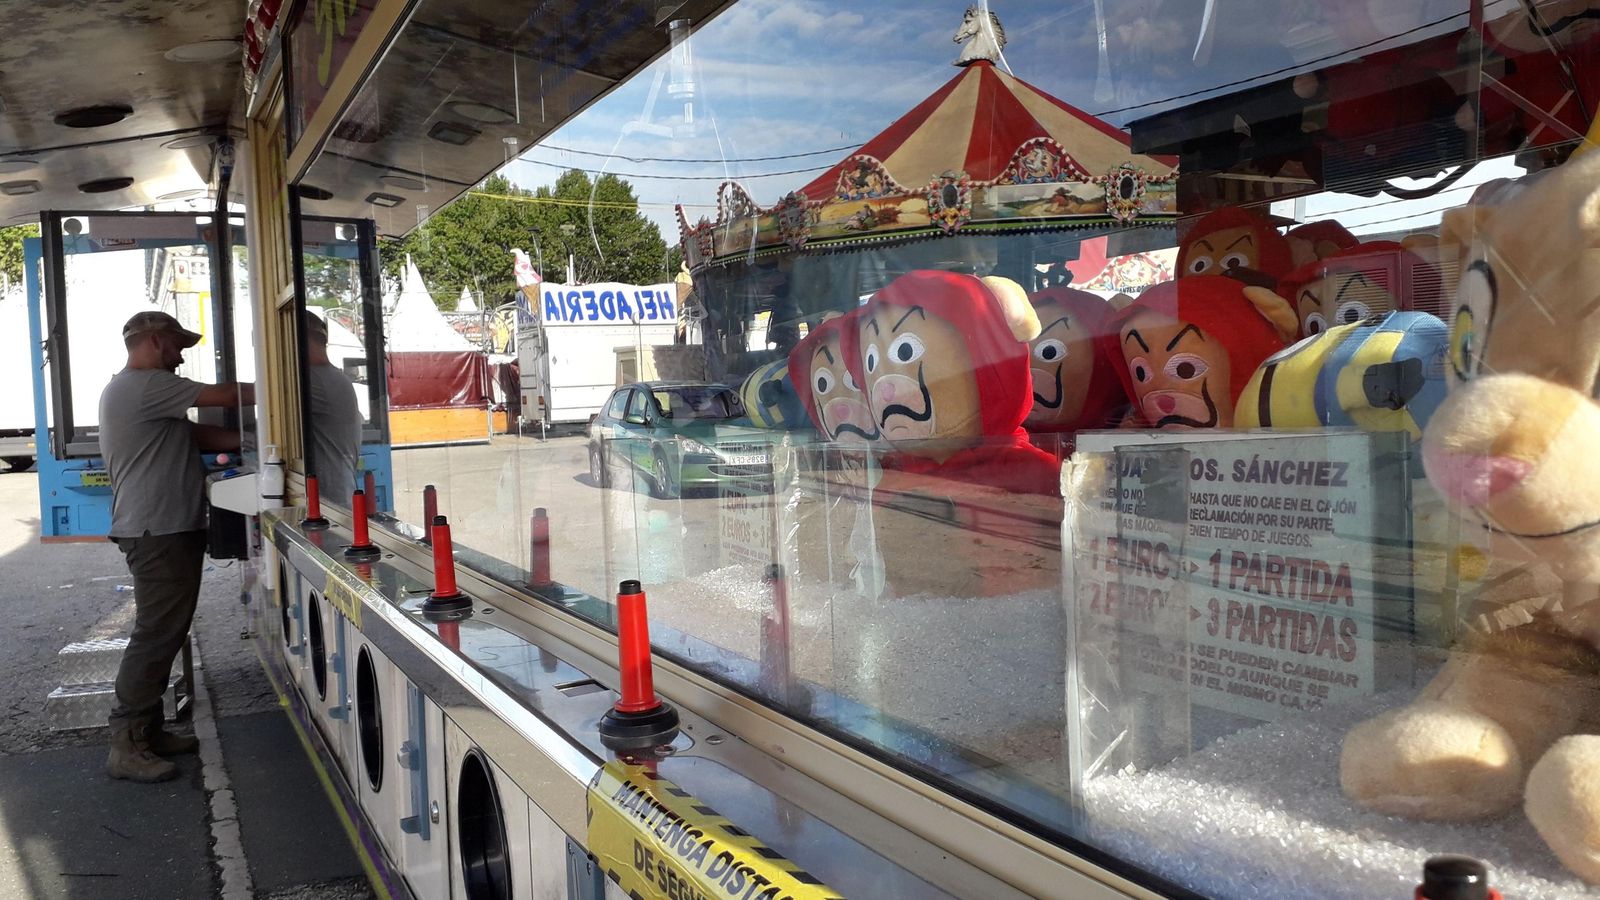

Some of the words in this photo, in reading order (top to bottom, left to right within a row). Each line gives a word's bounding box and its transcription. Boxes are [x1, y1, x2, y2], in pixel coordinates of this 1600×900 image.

[1190, 458, 1224, 482] OS.
[1232, 454, 1349, 487] SÁNCHEZ
[1190, 492, 1219, 506] HASTA
[1222, 494, 1242, 507] QUE
[1244, 495, 1258, 508] NO
[1260, 496, 1281, 510] CAE
[1284, 498, 1297, 511] EN
[1300, 499, 1313, 512] EL
[1316, 500, 1357, 514] CAJÓN
[1190, 524, 1211, 538] ENEN
[1214, 526, 1249, 541] TIEMPO
[1252, 530, 1264, 543] DE
[1267, 532, 1312, 547] JUEGOS.
[1256, 513, 1277, 527] POR
[1280, 515, 1294, 528] SU
[1297, 516, 1335, 534] PARTE,
[1209, 548, 1221, 588] 1
[1229, 550, 1354, 607] PARTIDA
[1207, 597, 1220, 637] 3
[1225, 599, 1358, 662] PARTIDAS
[1219, 648, 1279, 672] PUEDEN
[1282, 661, 1359, 688] CAMBIAR
[1239, 668, 1303, 694] AUNQUE
[612, 780, 714, 869] MANTENGA
[634, 838, 655, 883] DE
